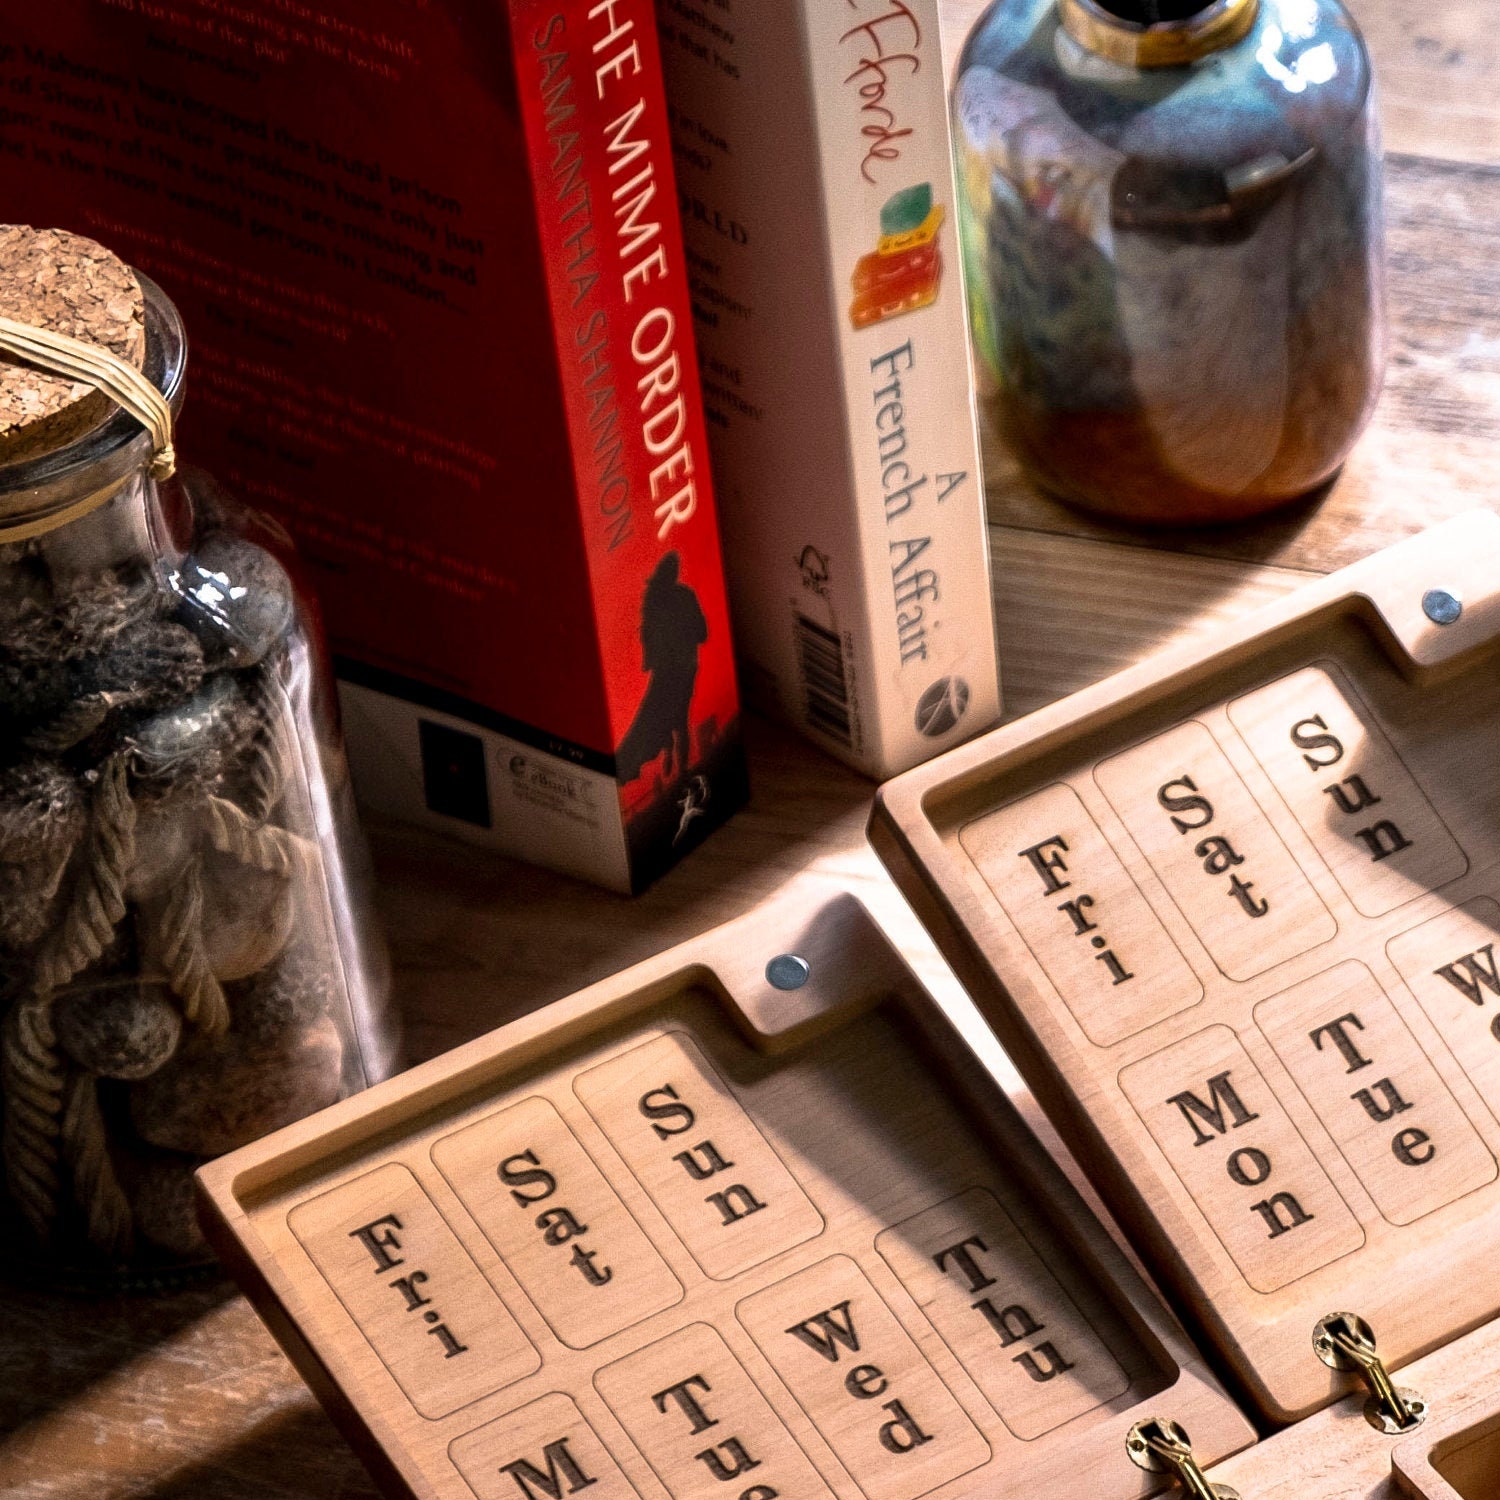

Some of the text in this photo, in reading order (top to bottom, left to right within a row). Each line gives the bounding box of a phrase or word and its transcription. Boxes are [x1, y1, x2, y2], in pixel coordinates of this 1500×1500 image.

[314, 139, 380, 184] brutal
[389, 173, 461, 216] prison
[390, 206, 436, 241] only
[444, 223, 483, 258] just
[603, 97, 669, 304] MIME
[332, 242, 355, 272] in
[341, 220, 432, 274] missing
[437, 256, 478, 287] and
[533, 12, 636, 554] SAMANTHA SHANNON
[630, 306, 698, 541] ORDER
[935, 469, 968, 503] A
[870, 337, 939, 667] French Affair
[1156, 774, 1270, 920] Sat
[1289, 713, 1415, 864] Sun
[1017, 834, 1135, 987] Fri
[637, 1082, 768, 1227] Sun
[1165, 1069, 1316, 1241] Mon
[1309, 1012, 1437, 1168] Tue
[348, 1212, 469, 1360] Fri
[495, 1148, 613, 1288] Sat
[784, 1299, 934, 1456] Wed
[931, 1235, 1077, 1384] Thu
